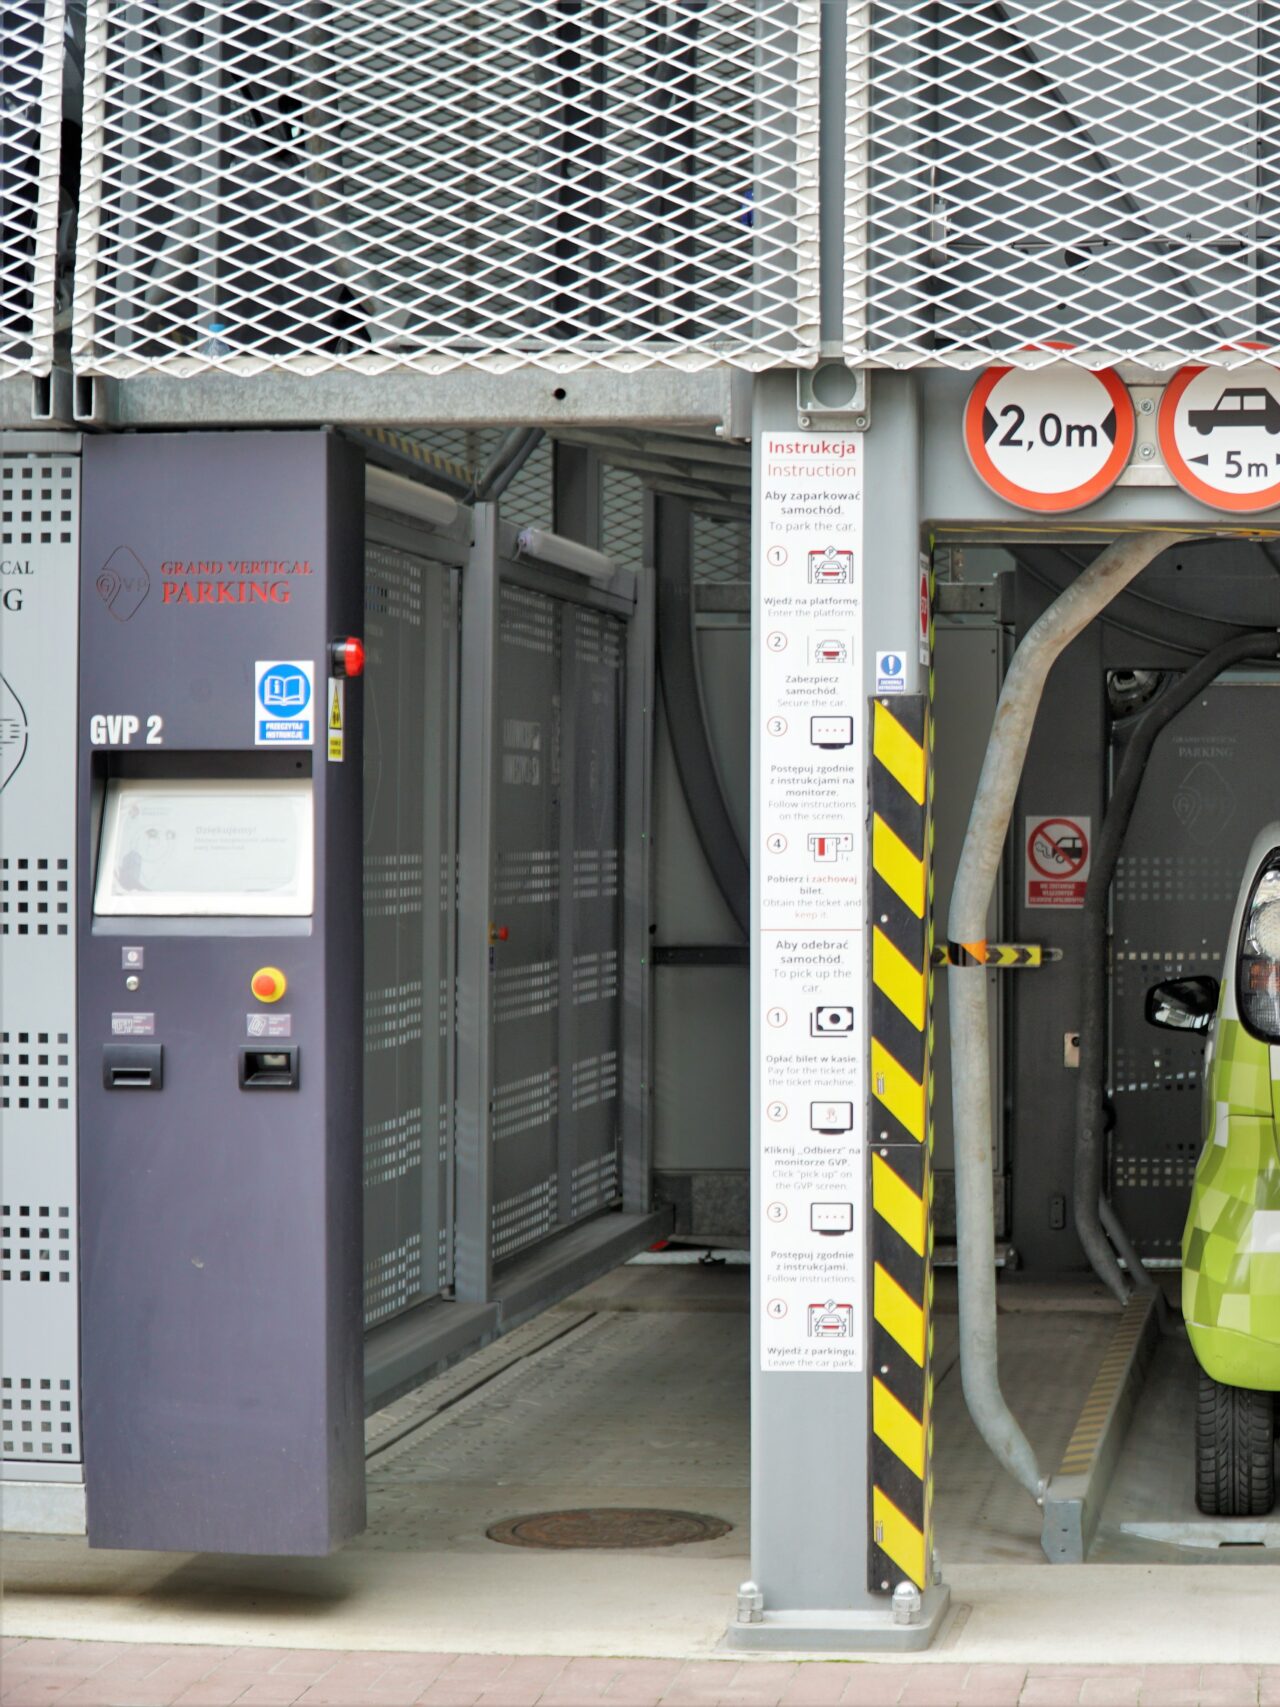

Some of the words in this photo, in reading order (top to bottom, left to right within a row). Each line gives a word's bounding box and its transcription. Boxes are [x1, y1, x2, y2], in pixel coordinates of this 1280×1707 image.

[999, 404, 1098, 451] 2,0m
[769, 440, 856, 458] Instrukcja
[768, 463, 856, 477] Instruction
[765, 491, 786, 503] Aby
[791, 491, 860, 503] zaparkować
[781, 504, 845, 515] samochód.
[769, 521, 782, 531] To
[786, 521, 811, 533] park
[815, 521, 832, 531] the
[836, 522, 856, 532] car.
[774, 550, 781, 562] 1
[161, 560, 223, 576] GRAND
[227, 560, 314, 576] VERTICAL
[162, 580, 291, 604] PARKING
[768, 609, 792, 617] Enter
[795, 609, 811, 617] the
[774, 636, 781, 647] 2
[785, 675, 839, 685] Zabezpiecz
[777, 699, 809, 708] Secure
[812, 699, 827, 707] the
[90, 714, 139, 745] GVP
[146, 714, 163, 745] 2
[774, 721, 781, 732] 3
[771, 765, 814, 775] Postępuj
[816, 765, 854, 775] zgodnie
[778, 777, 840, 787] instrukcjami
[768, 801, 798, 809] Follow
[801, 801, 857, 809] instructions
[794, 812, 809, 820] the
[773, 838, 781, 849] 4
[767, 875, 803, 884] Pobierz
[812, 875, 857, 886] zachowaj
[763, 899, 795, 907] Obtain
[797, 899, 813, 907] the
[815, 899, 841, 907] ticket
[844, 899, 862, 907] and
[776, 940, 798, 952] Aby
[801, 939, 849, 950] odebrać
[780, 955, 845, 965] samochód.
[773, 968, 786, 978] To
[790, 968, 812, 980] pick
[816, 971, 830, 980] up
[833, 968, 852, 978] the
[801, 984, 822, 993] car.
[775, 1011, 781, 1023] 1
[766, 1055, 792, 1065] Opłać
[796, 1055, 817, 1064] bilet
[767, 1066, 784, 1075] Pay
[786, 1066, 800, 1074] for
[802, 1066, 817, 1074] the
[820, 1066, 845, 1074] ticket
[768, 1078, 783, 1086] the
[786, 1078, 812, 1086] ticket
[774, 1106, 781, 1117] 2
[764, 1146, 795, 1156] Kliknij
[775, 1158, 825, 1166] monitorze
[772, 1170, 794, 1178] Click
[776, 1182, 791, 1190] the
[794, 1182, 813, 1190] GVP
[774, 1207, 781, 1218] 3
[771, 1251, 814, 1261] Postępuj
[816, 1251, 854, 1261] zgodnie
[774, 1304, 781, 1314] 4
[767, 1347, 801, 1357] Wyjedź
[768, 1359, 795, 1367] Leave
[797, 1359, 813, 1367] the
